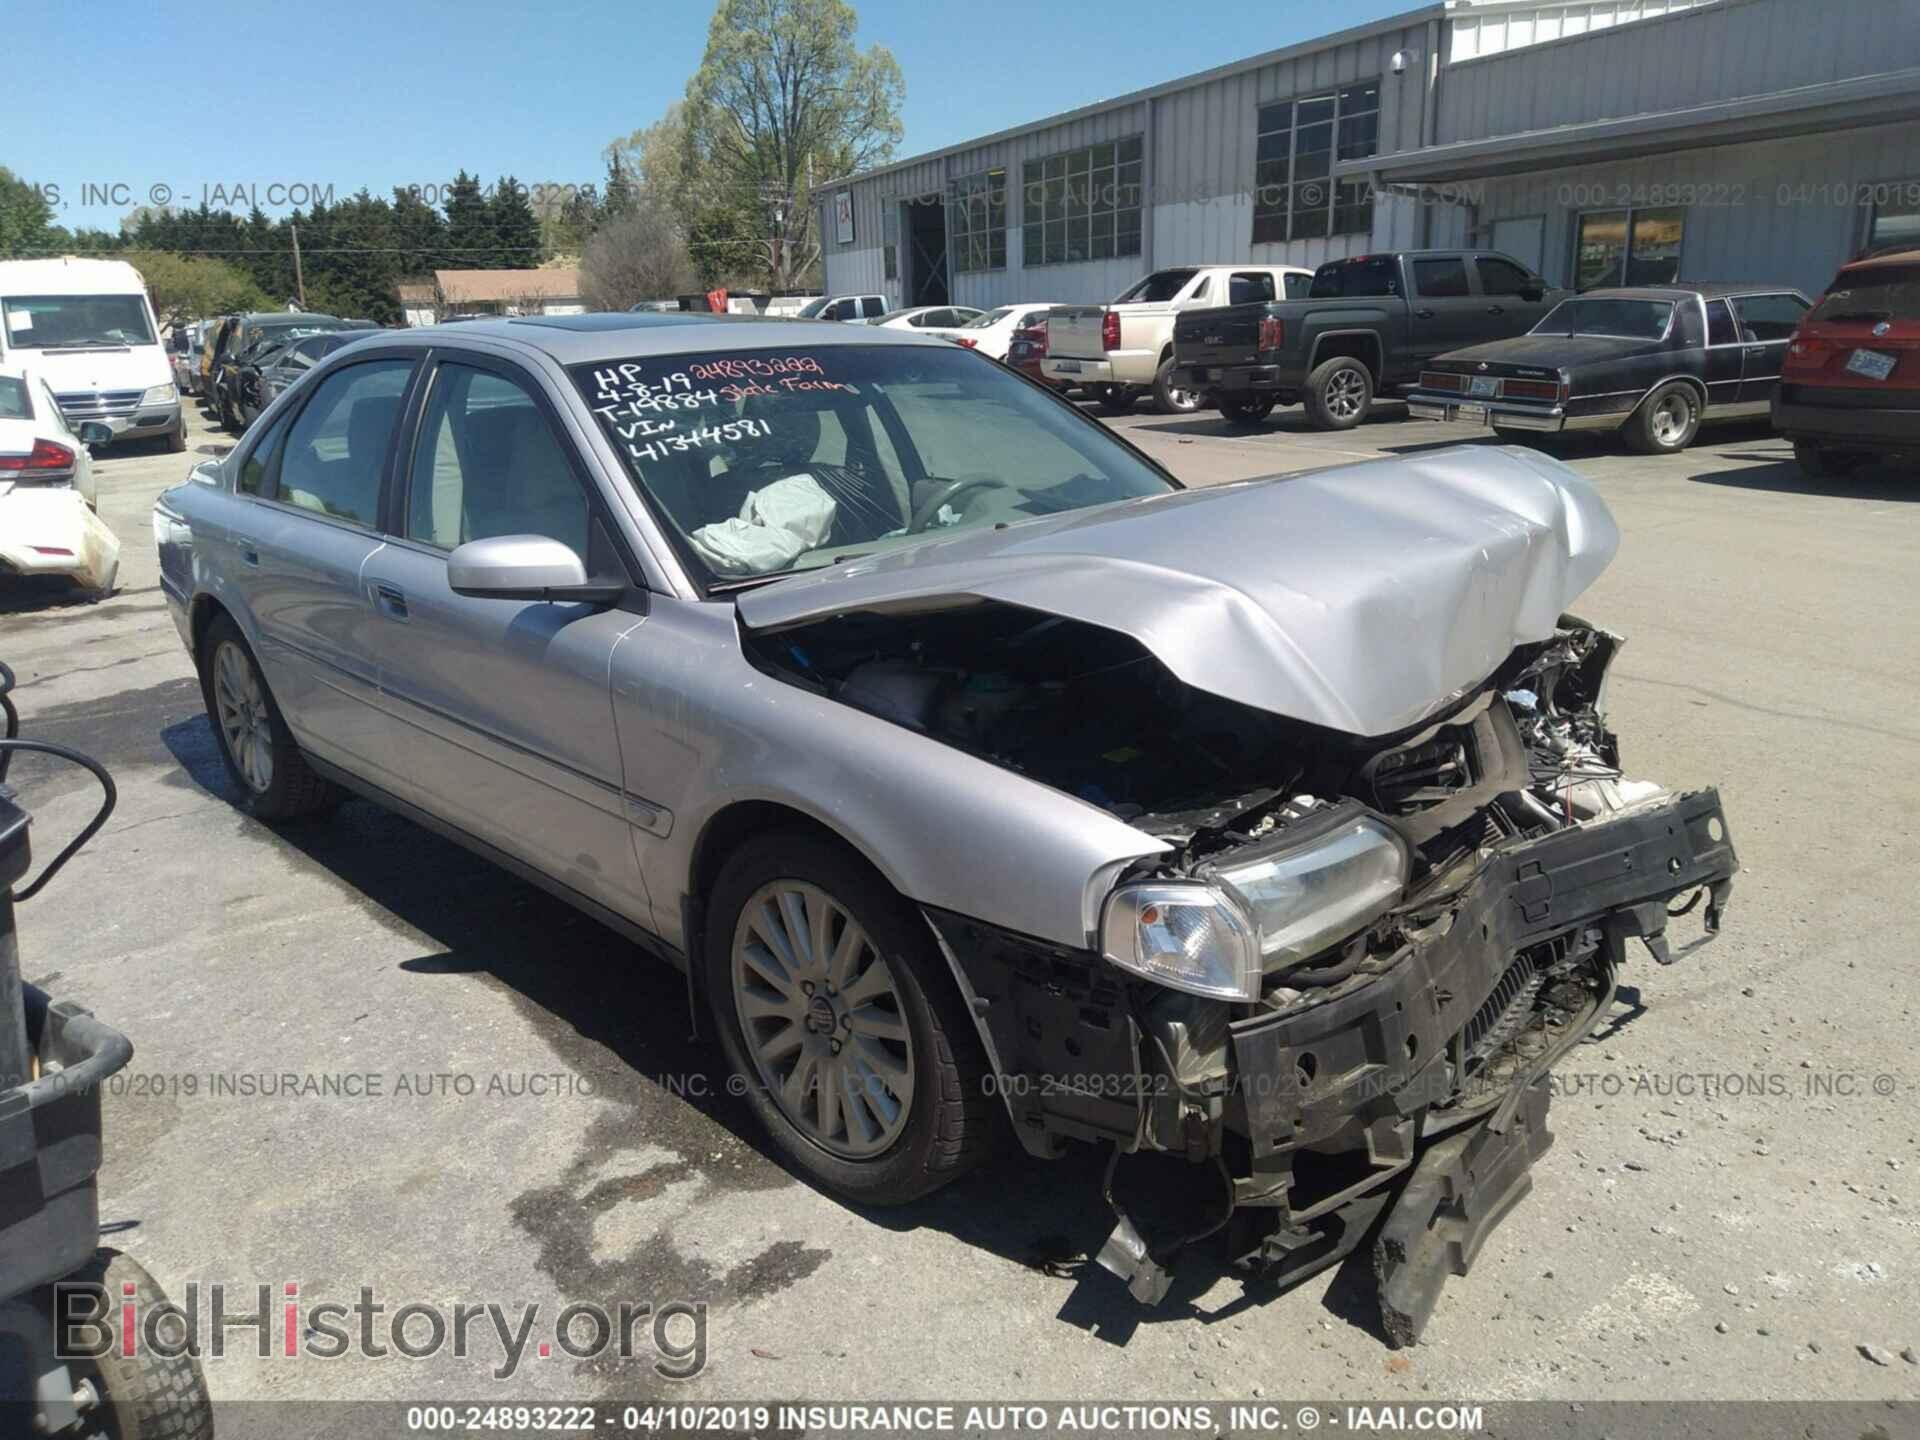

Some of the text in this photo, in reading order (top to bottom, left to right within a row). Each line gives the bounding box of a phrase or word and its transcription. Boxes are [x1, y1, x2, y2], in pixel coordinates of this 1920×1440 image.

[593, 363, 642, 391] HP
[689, 356, 824, 380] 24893222
[597, 372, 692, 402] 4-8-19
[719, 378, 779, 402] State
[592, 388, 719, 422] T-19884
[628, 418, 772, 462] 41344581
